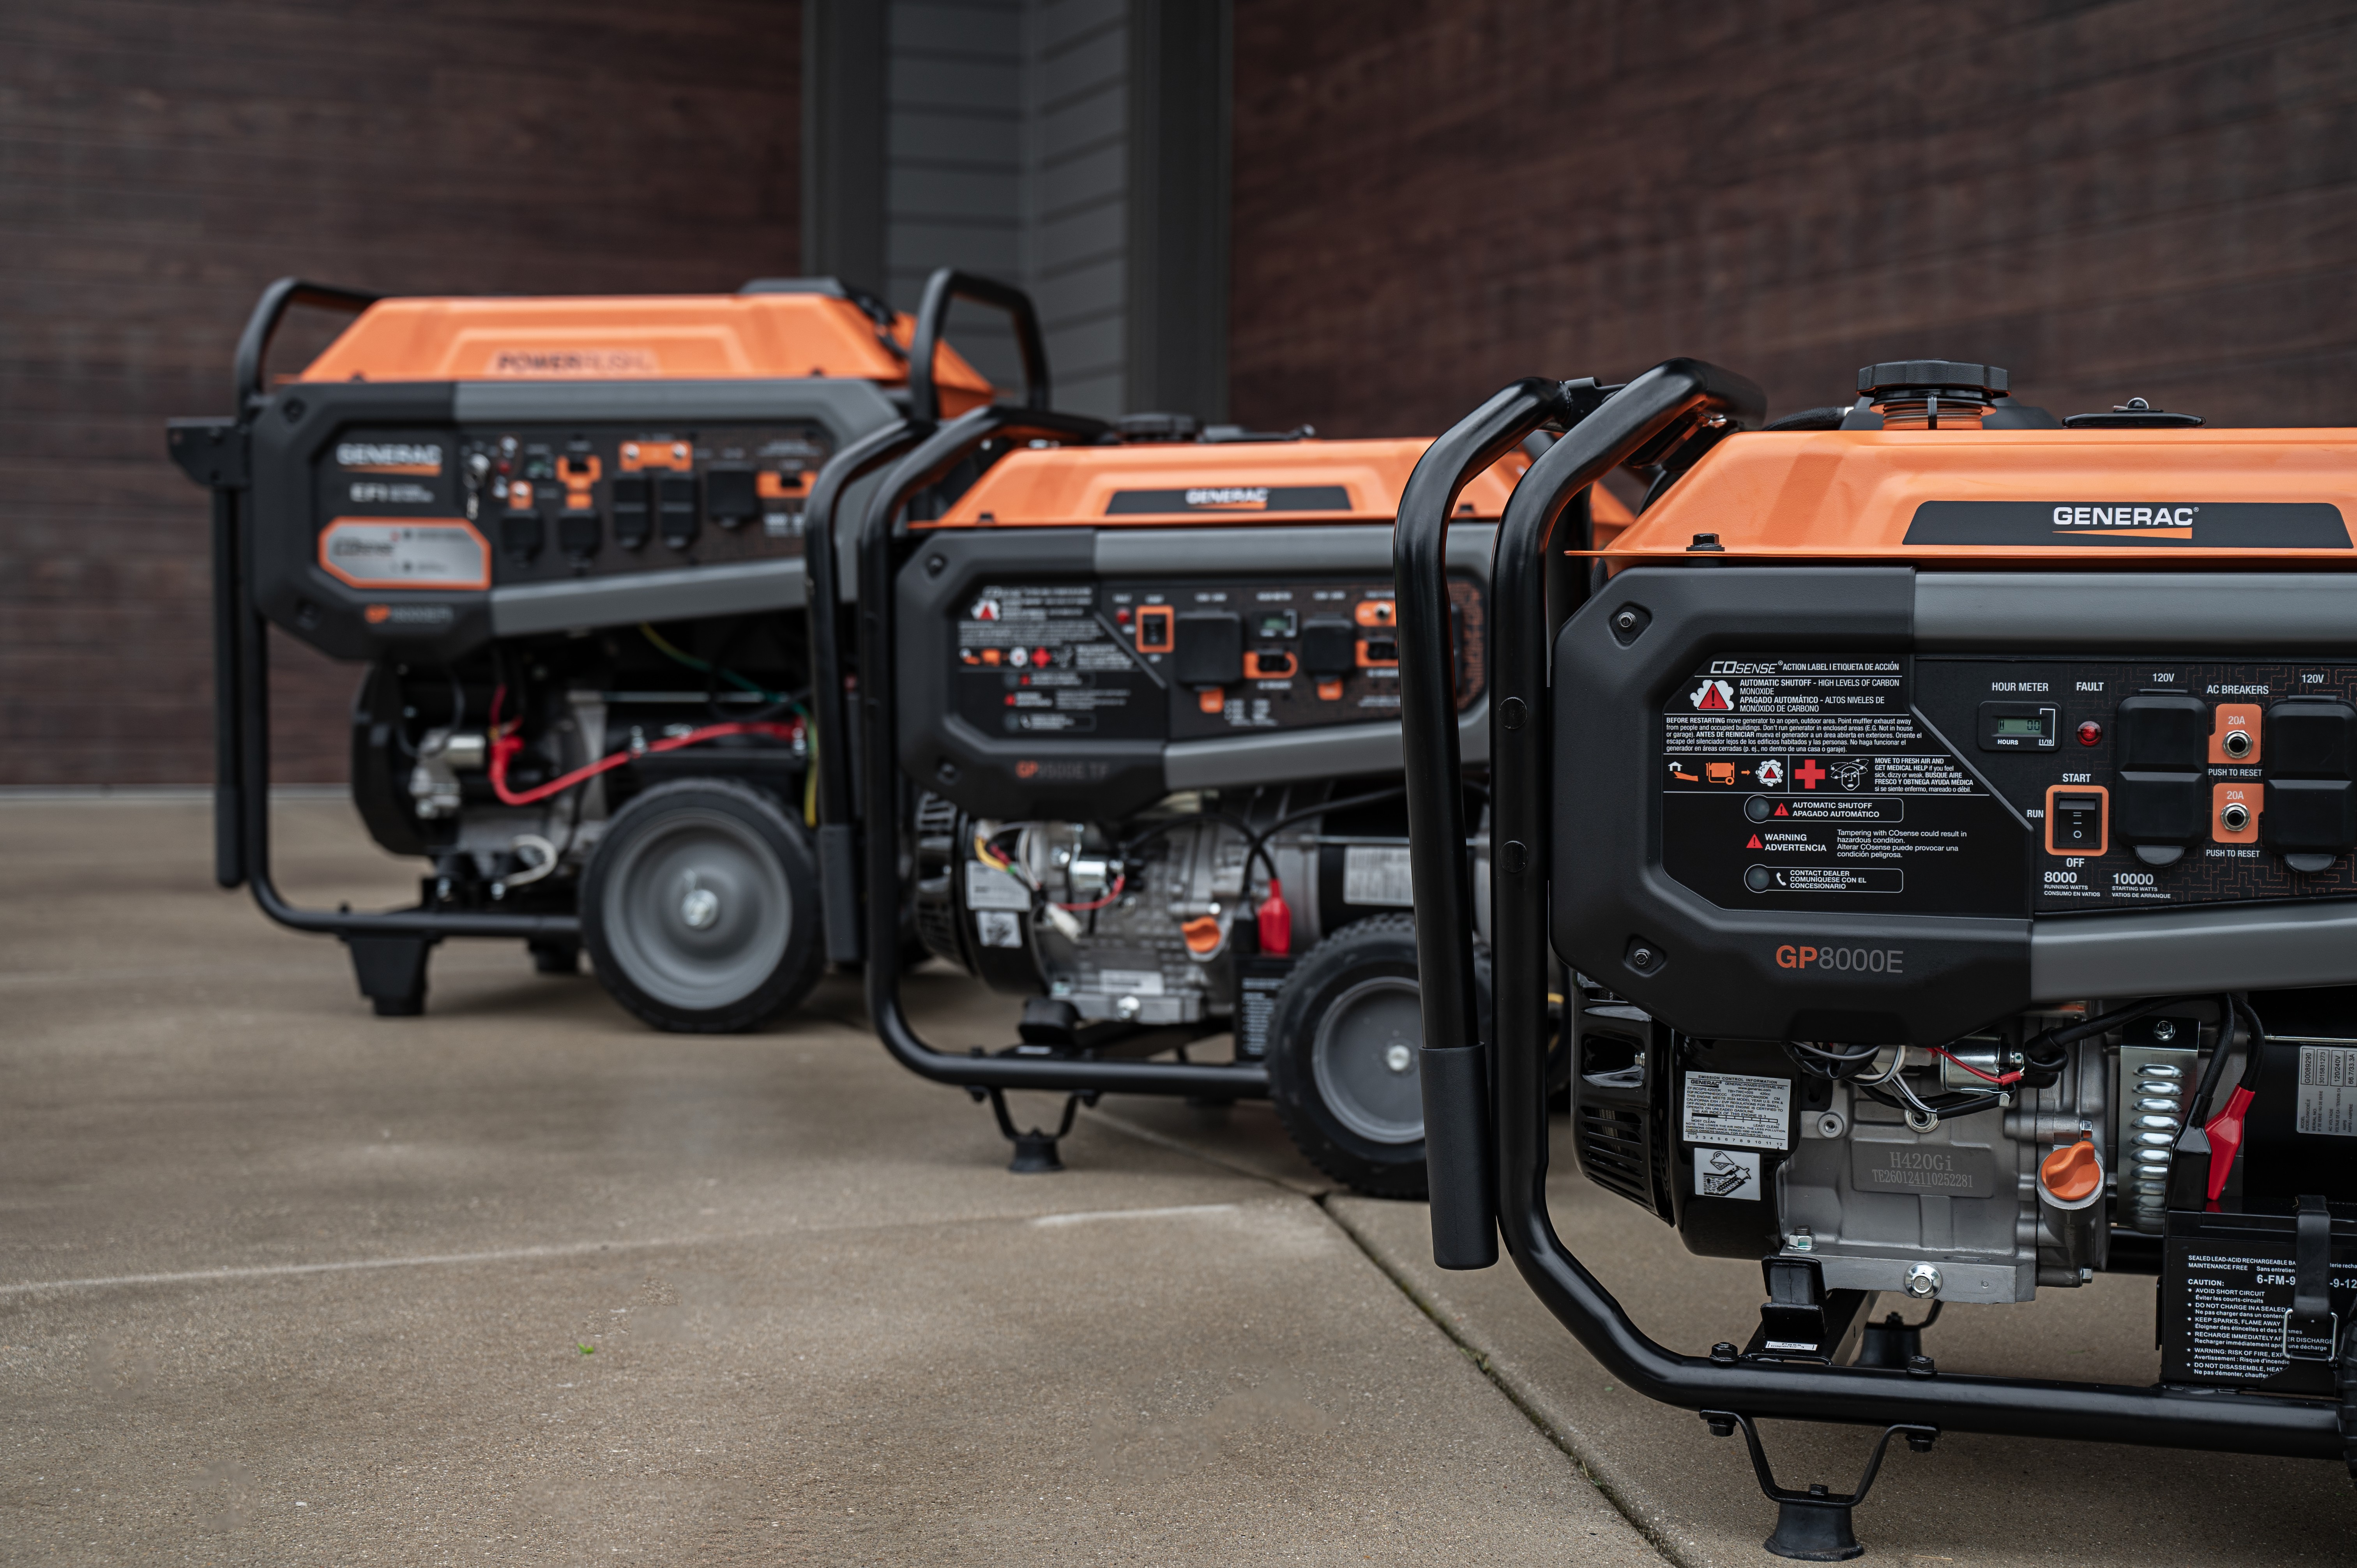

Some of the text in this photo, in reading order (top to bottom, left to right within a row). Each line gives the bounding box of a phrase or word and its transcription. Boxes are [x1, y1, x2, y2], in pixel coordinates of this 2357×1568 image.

[1186, 488, 1267, 504] GENERAC
[1832, 663, 1864, 671] ETIQUETA
[1874, 660, 1899, 671] ACCIÓN
[2152, 673, 2175, 682] 120V
[2301, 674, 2324, 683] 120V
[1992, 682, 2049, 692] HOUR METER
[2076, 682, 2104, 691] FAULT
[2206, 685, 2269, 695] AC BREAKERS
[1774, 694, 1818, 704] AUTOMÁTICO
[1740, 703, 1775, 712] MONÓXIDO
[2228, 715, 2246, 725] 20A
[2062, 773, 2092, 782] START
[2226, 791, 2244, 800] 20A
[1830, 809, 1880, 818] AUTOMÁTICO
[2027, 809, 2044, 818] RUN
[1765, 833, 1807, 841] WARNING
[1837, 829, 1871, 837] Tampering
[1764, 844, 1827, 852] ADVERTENCIA
[1871, 851, 1903, 859] peligrosa.
[2066, 857, 2085, 867] OFF
[2044, 871, 2078, 883] 8000
[2113, 873, 2154, 885] 10000
[1776, 945, 1903, 973] GP8000E
[1890, 1152, 1953, 1171] H420Gi
[1872, 1169, 1973, 1188] TE260124110252281
